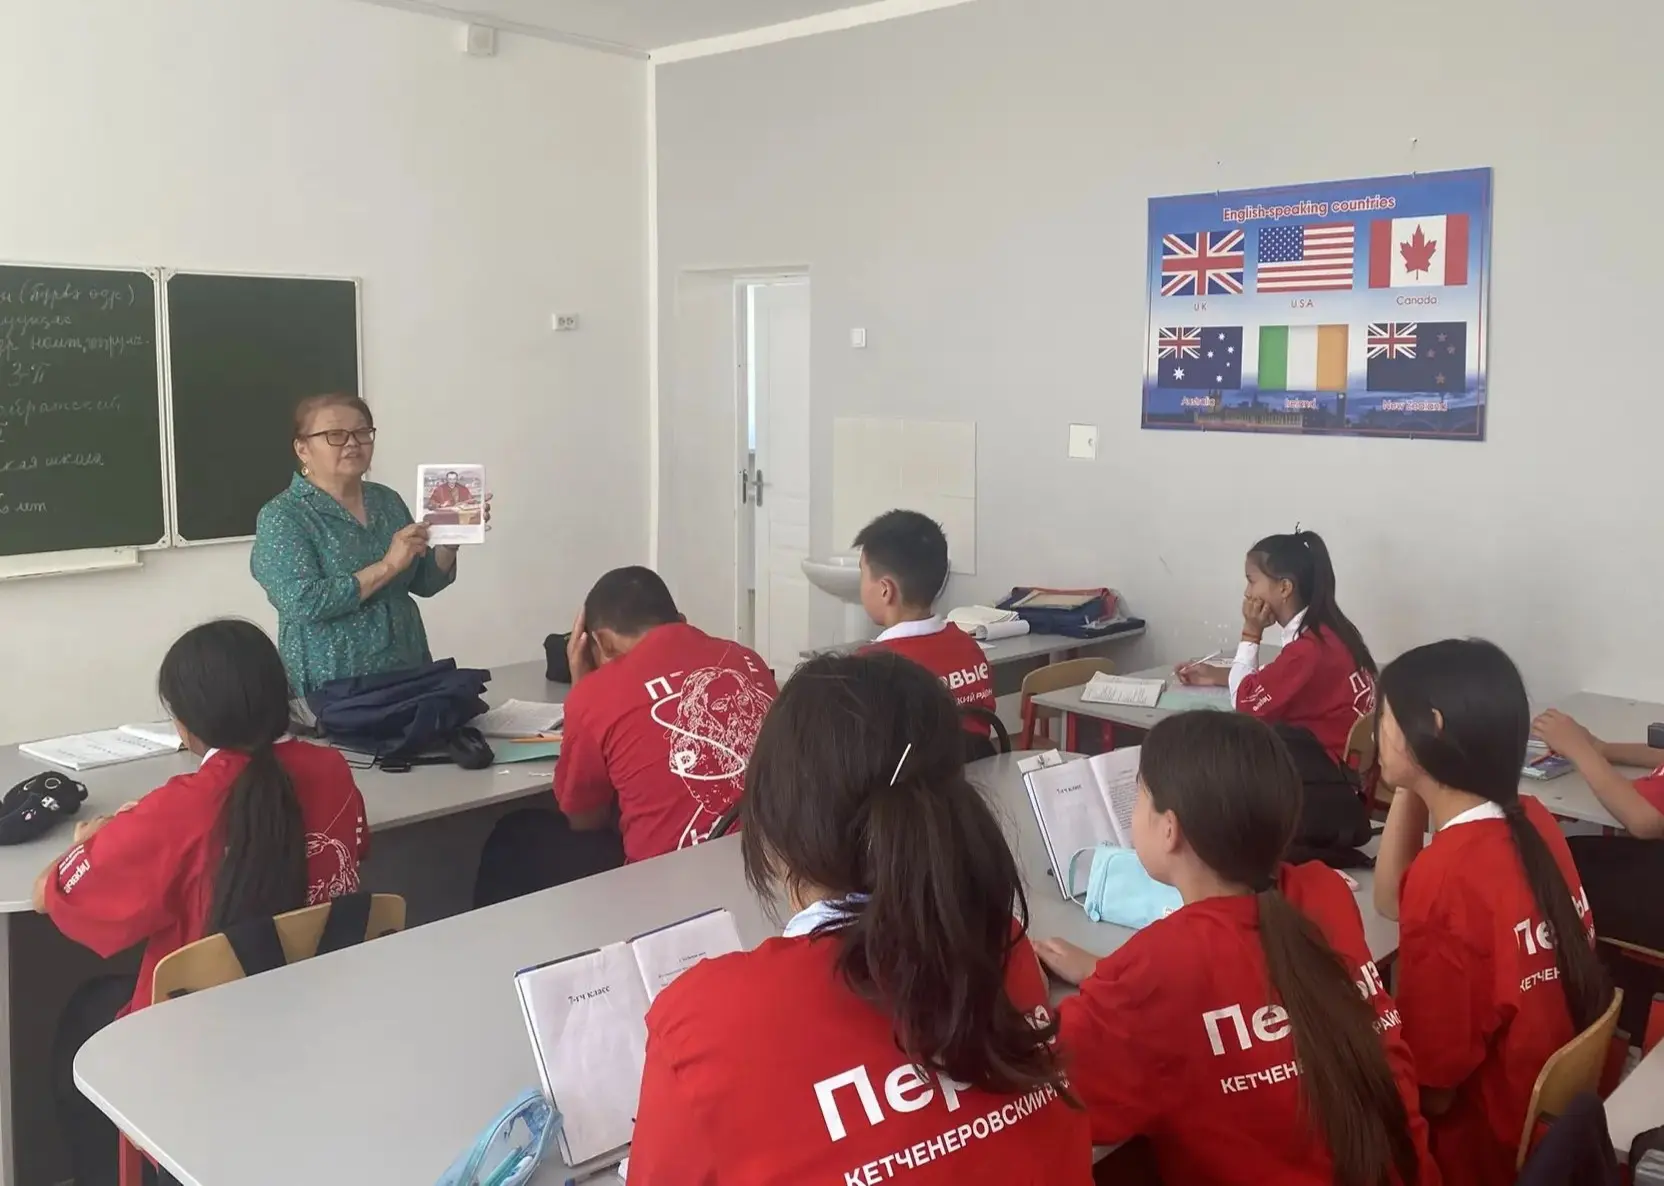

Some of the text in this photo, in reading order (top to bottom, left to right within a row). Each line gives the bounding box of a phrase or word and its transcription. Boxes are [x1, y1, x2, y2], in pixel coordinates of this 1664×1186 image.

[1223, 194, 1396, 223] English-speaking countries
[1290, 299, 1315, 309] USA
[1396, 294, 1438, 306] Canada
[1193, 301, 1208, 312] UK
[1382, 399, 1406, 411] New
[938, 662, 989, 690] вые
